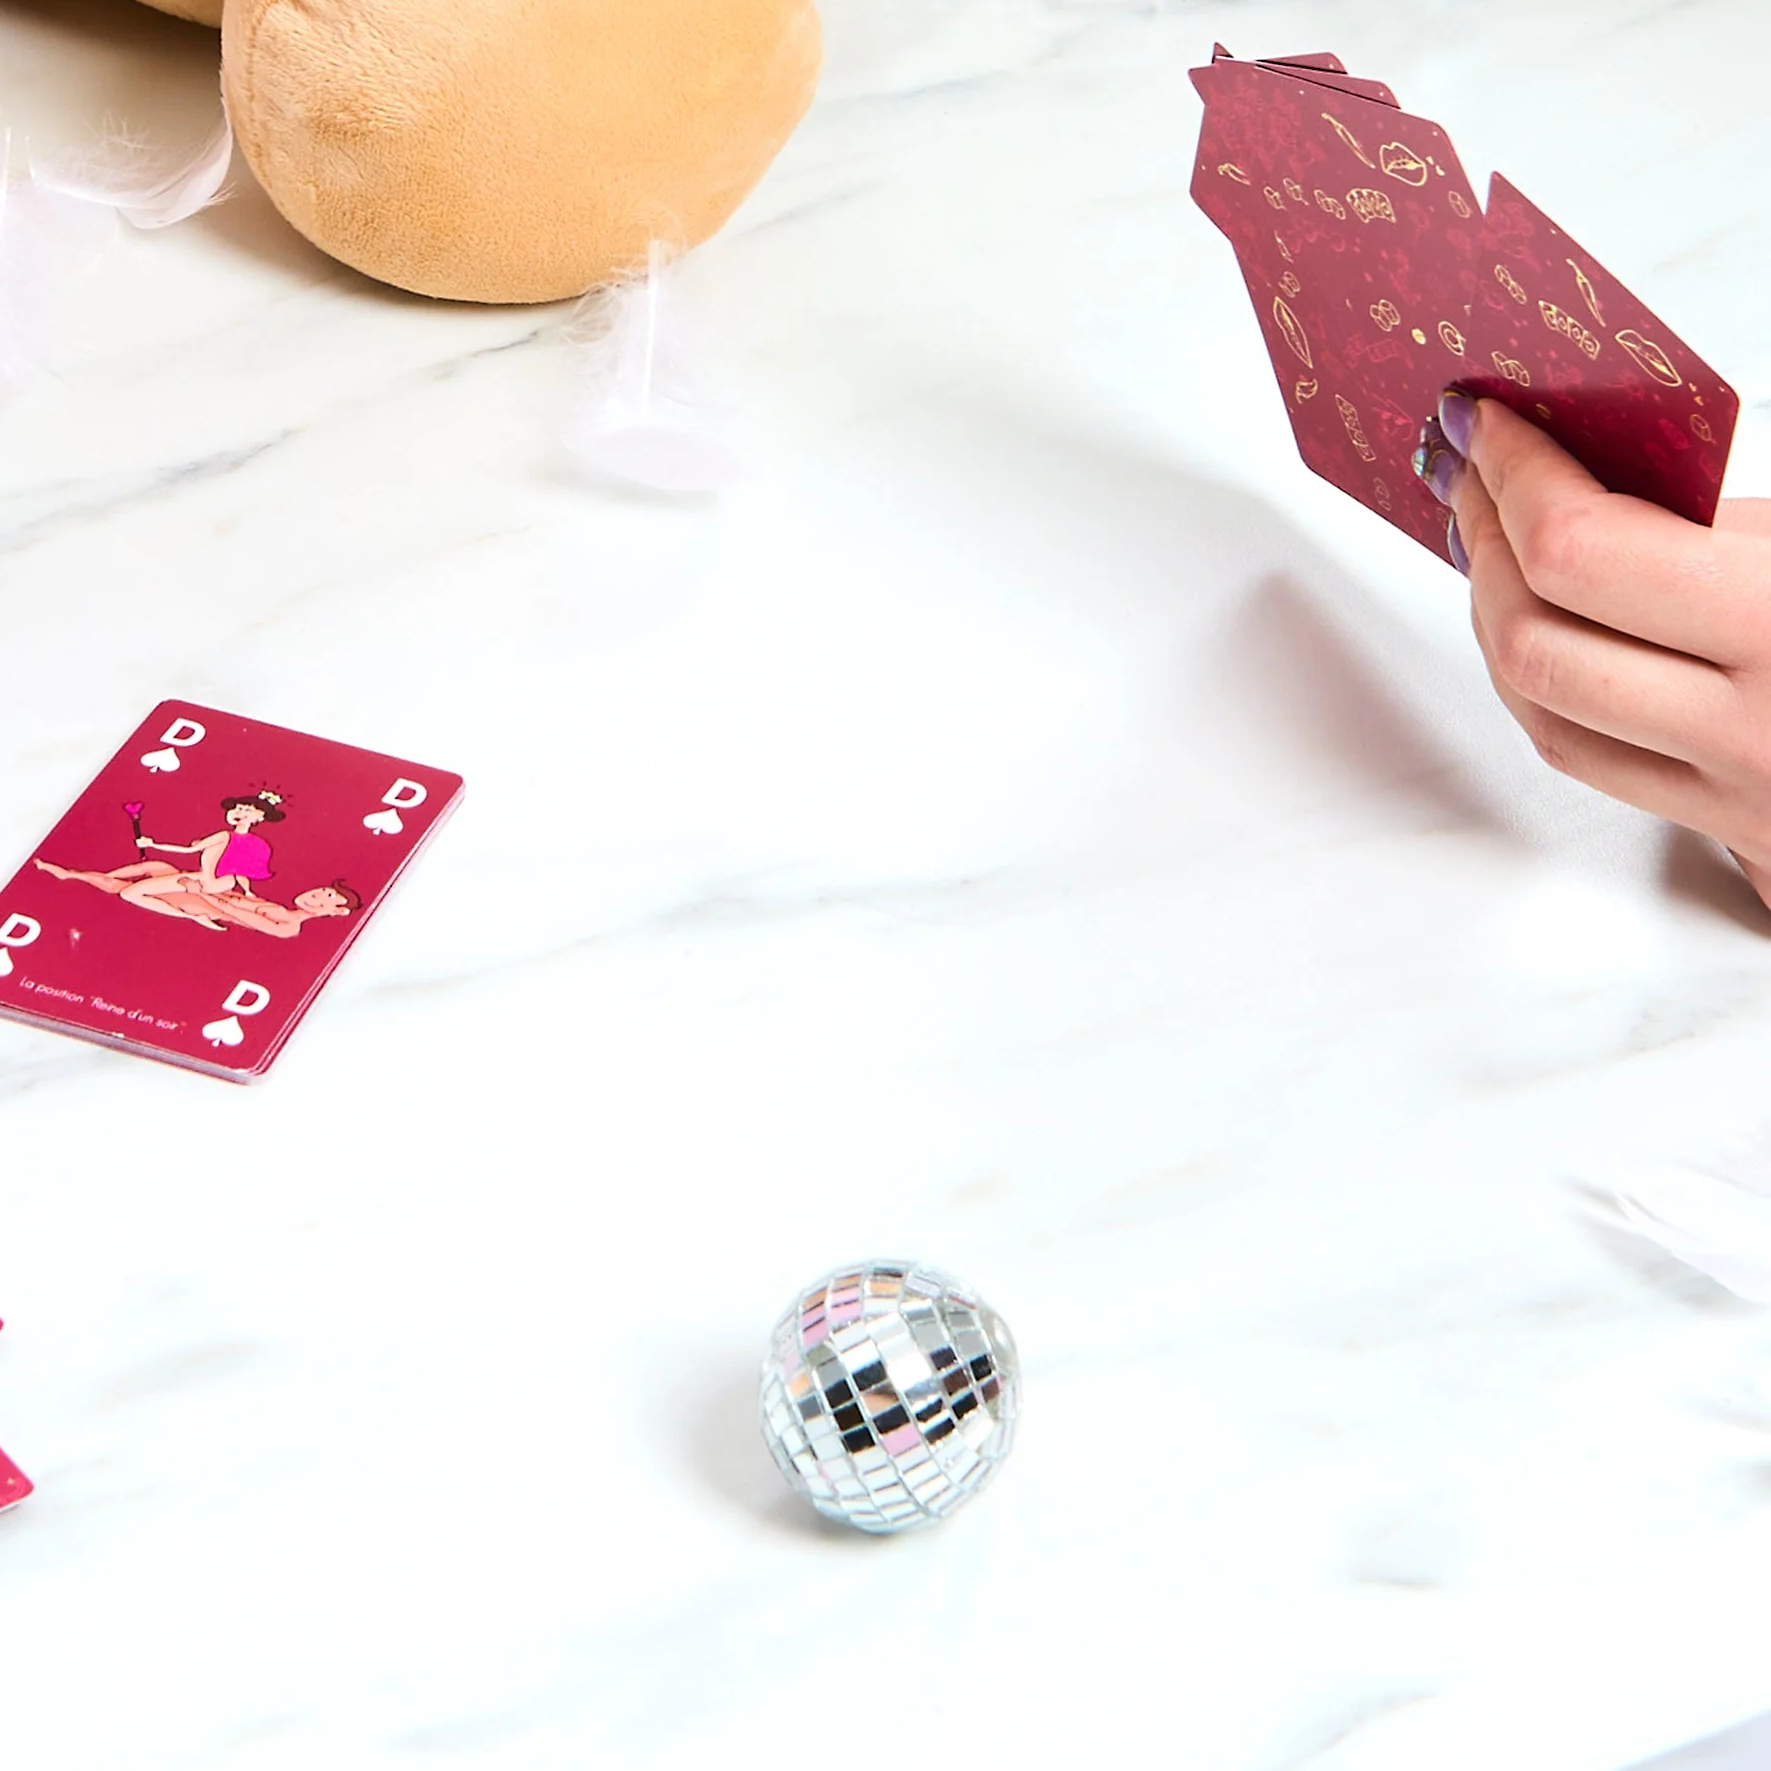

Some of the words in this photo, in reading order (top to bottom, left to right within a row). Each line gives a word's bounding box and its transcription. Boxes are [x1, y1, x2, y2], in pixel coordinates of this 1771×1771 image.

[159, 718, 207, 747] D
[381, 778, 428, 808] D
[20, 976, 35, 988] La
[35, 984, 84, 1004] position
[127, 1009, 153, 1024] d'un
[222, 980, 270, 1014] D
